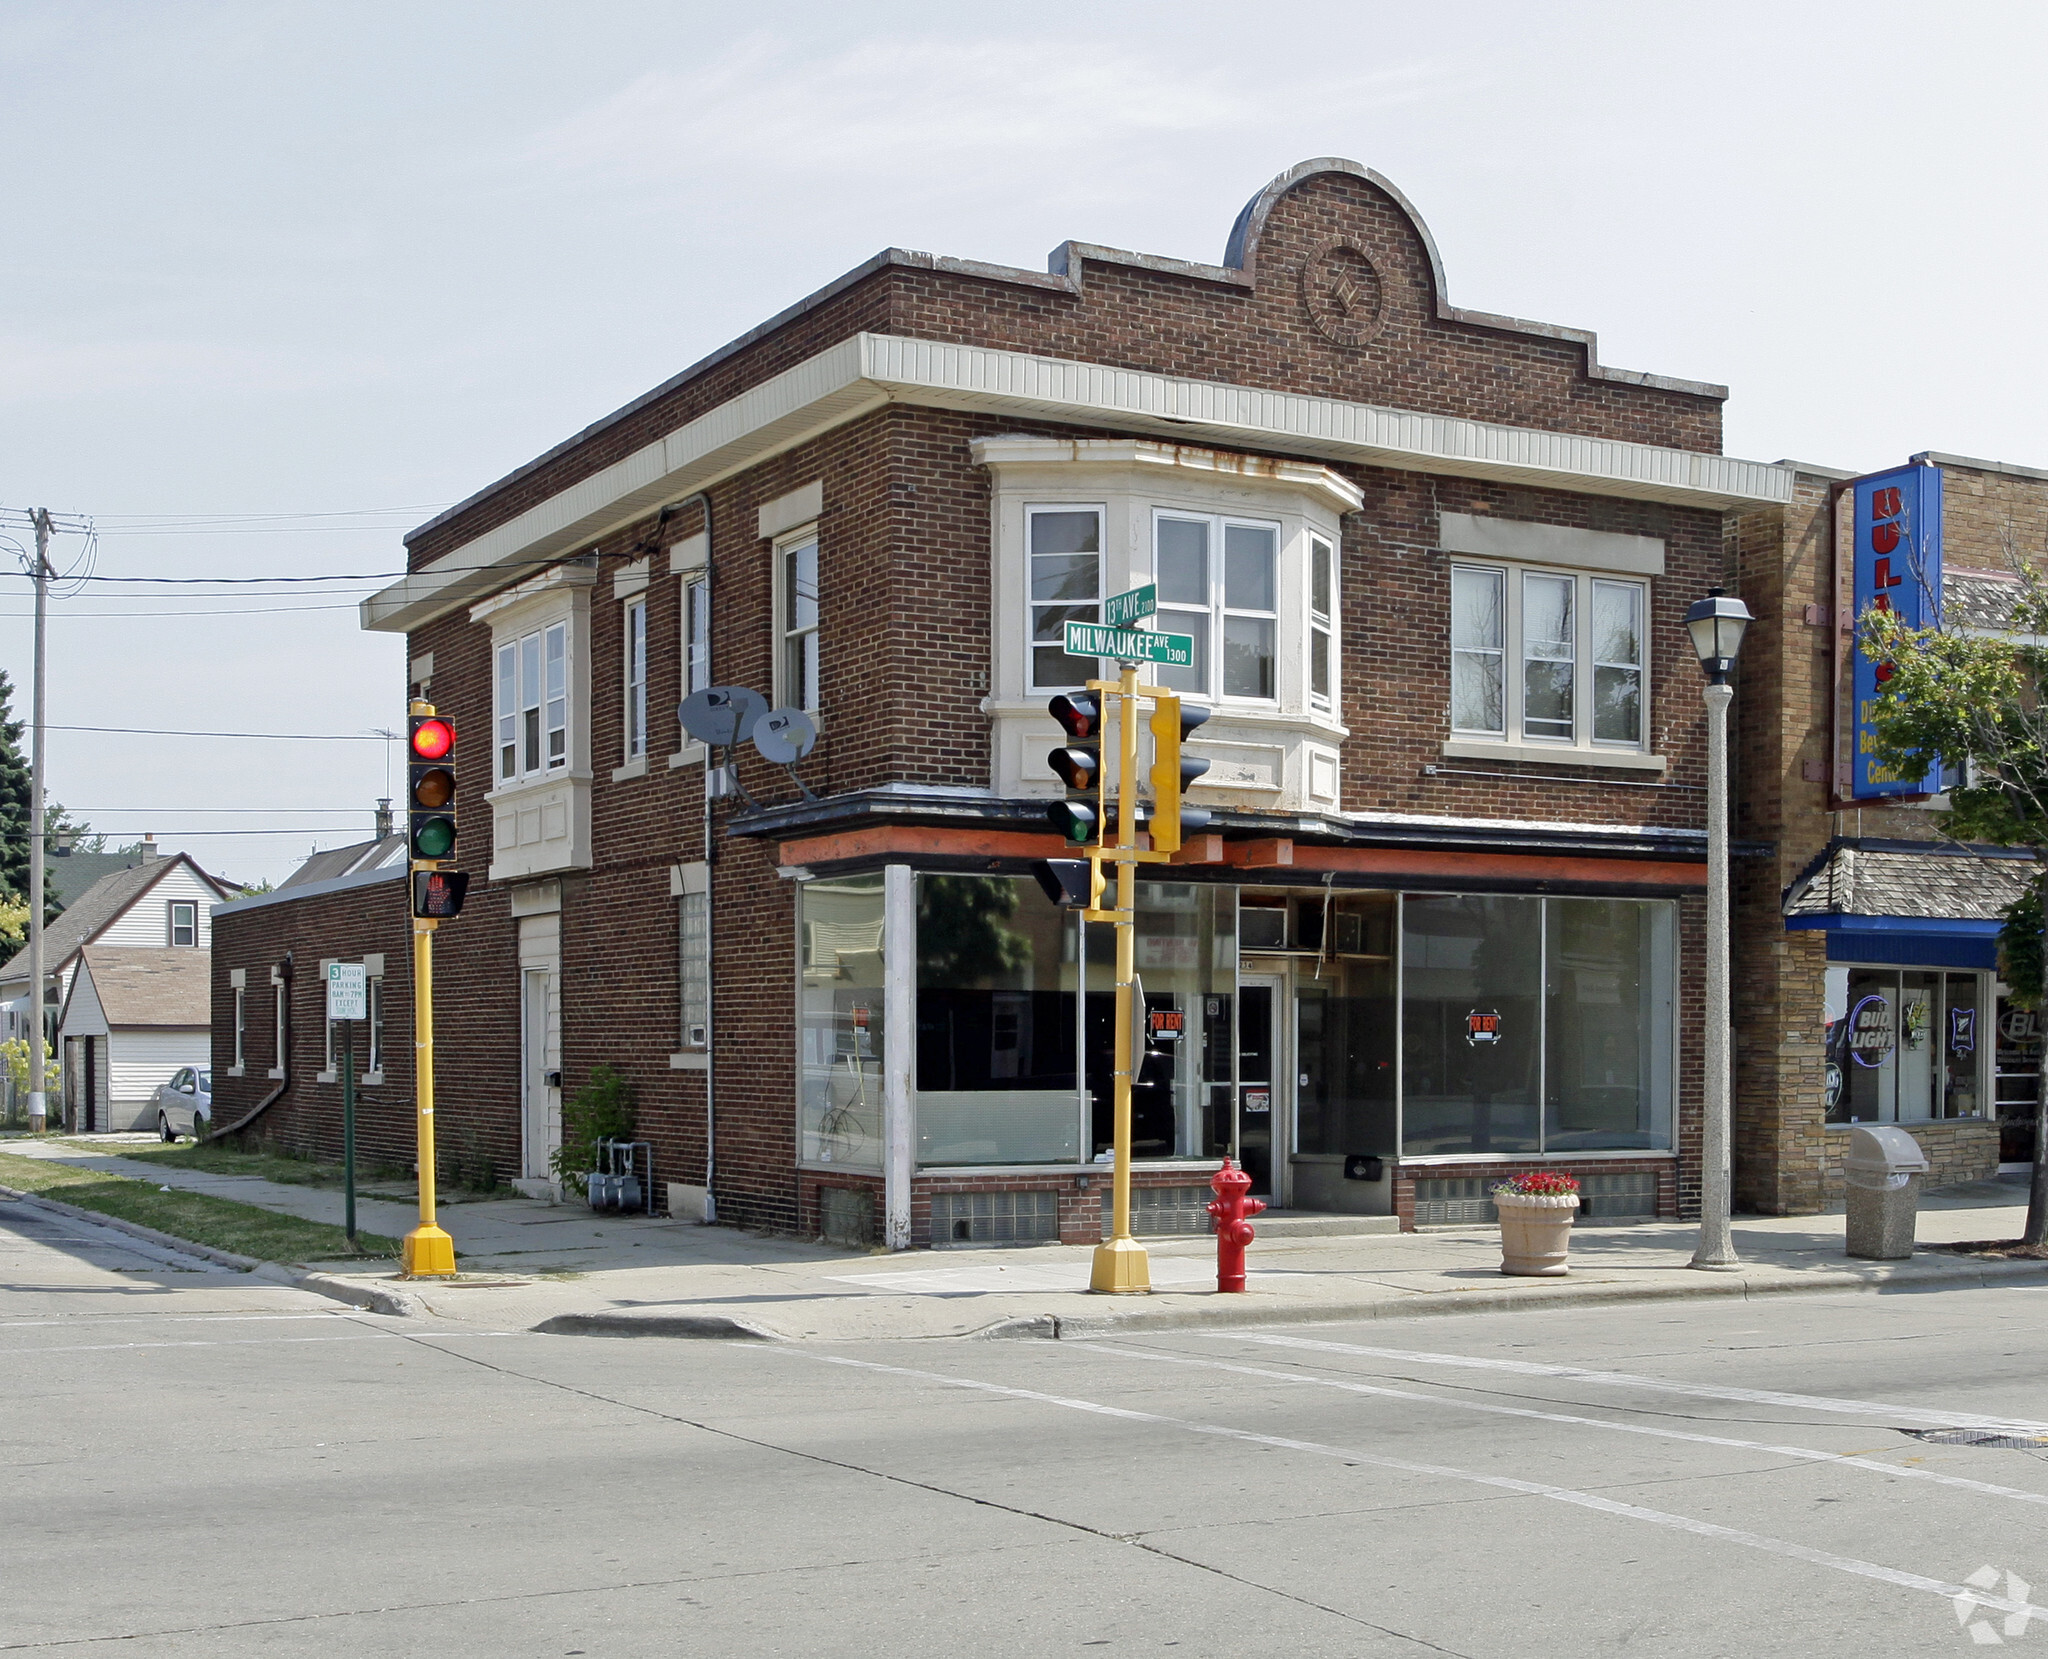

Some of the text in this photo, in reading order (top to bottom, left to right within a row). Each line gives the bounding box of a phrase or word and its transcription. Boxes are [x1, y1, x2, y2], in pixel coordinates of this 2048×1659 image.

[1122, 592, 1140, 620] AVE
[1070, 626, 1186, 662] MILWAUKEE AVE 1300
[331, 968, 339, 978] 3
[1152, 1013, 1182, 1030] FOR RENT
[1471, 1016, 1498, 1031] FOR RENT
[1860, 1012, 1888, 1028] BUD
[1852, 1031, 1895, 1049] LIGHT
